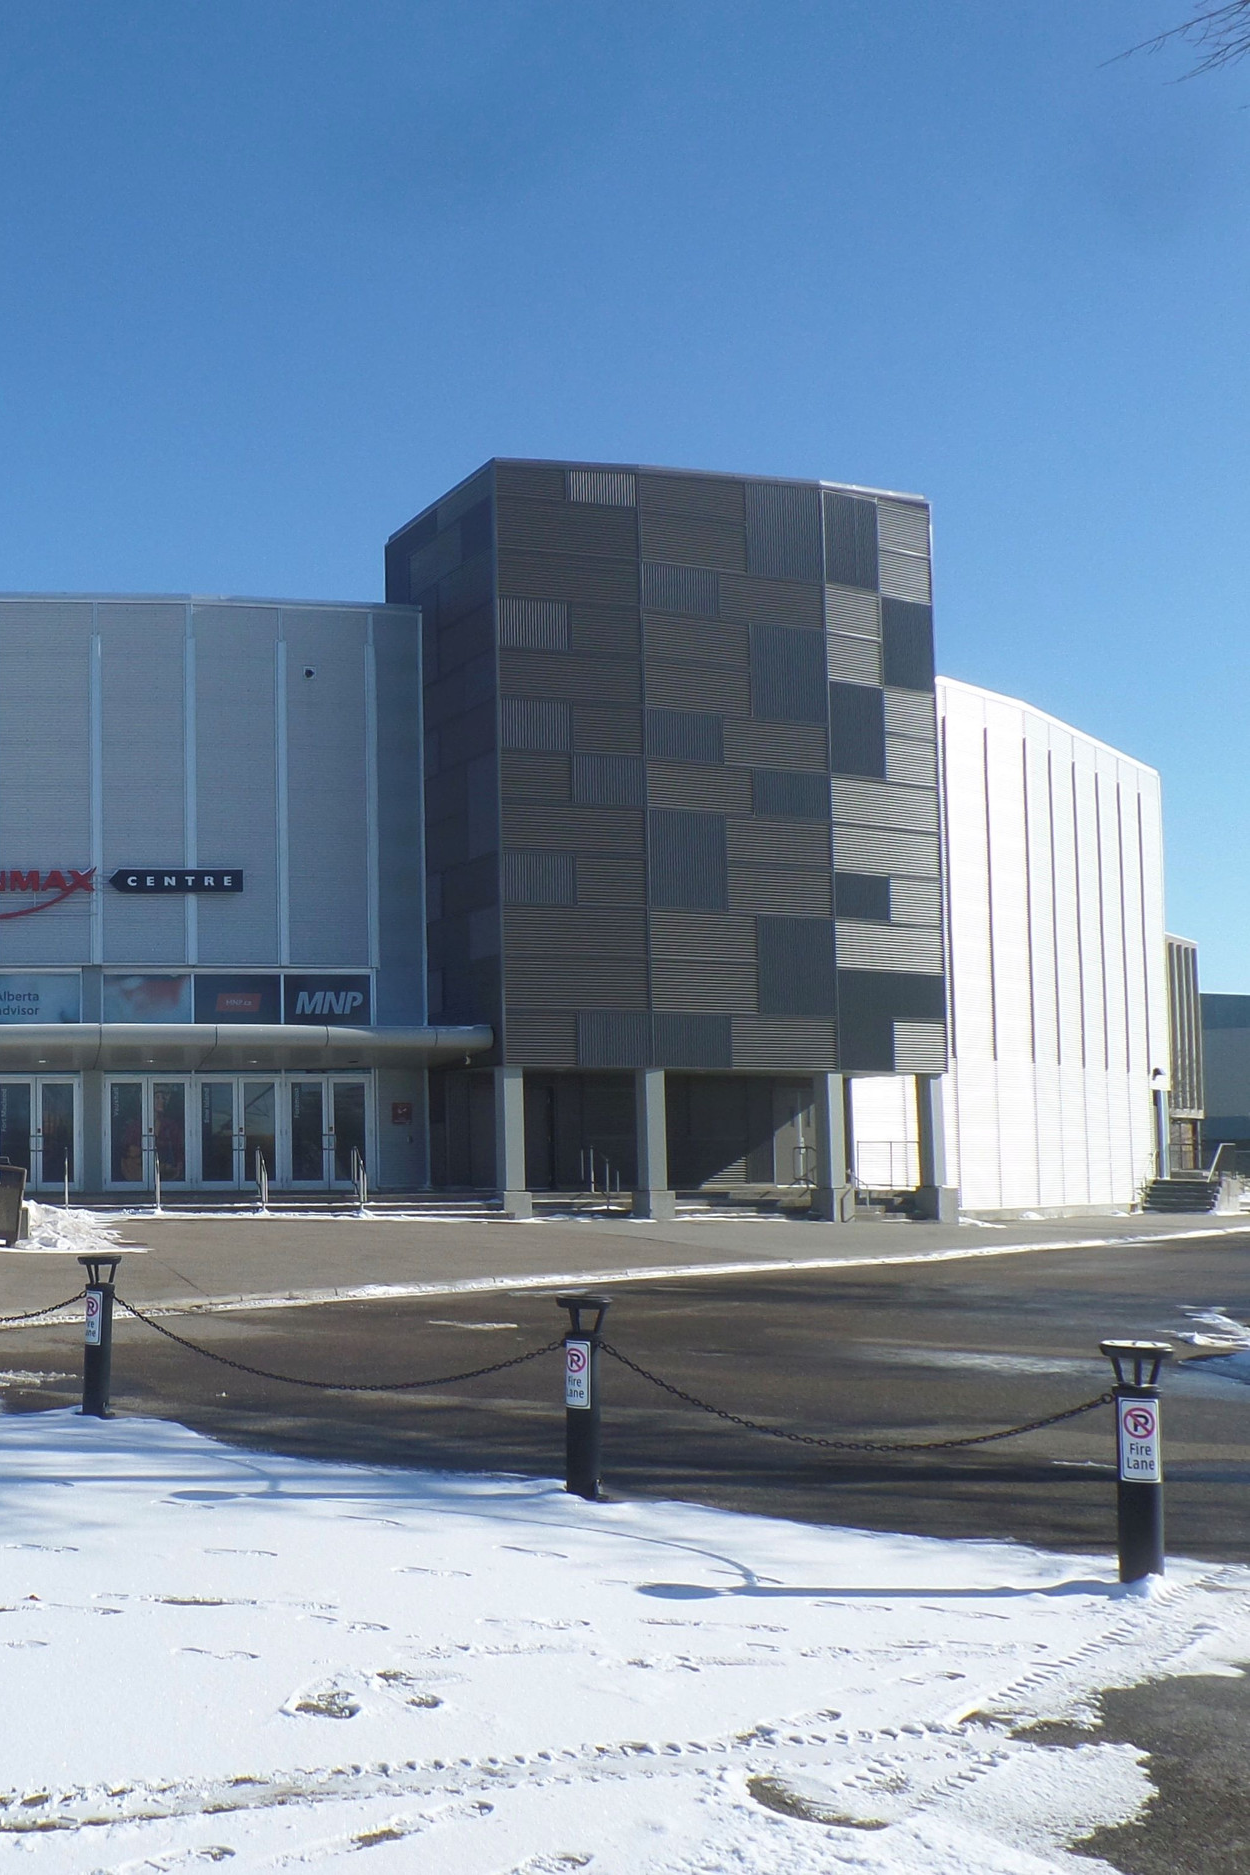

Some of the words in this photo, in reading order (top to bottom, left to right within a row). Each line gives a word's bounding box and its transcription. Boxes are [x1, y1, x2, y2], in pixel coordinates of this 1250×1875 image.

[127, 875, 233, 887] CENTRE
[295, 991, 364, 1015] MNP
[568, 1376, 582, 1387] Fire
[566, 1388, 585, 1399] Lane
[1129, 1442, 1152, 1456] Fire
[1126, 1457, 1155, 1470] Lane
